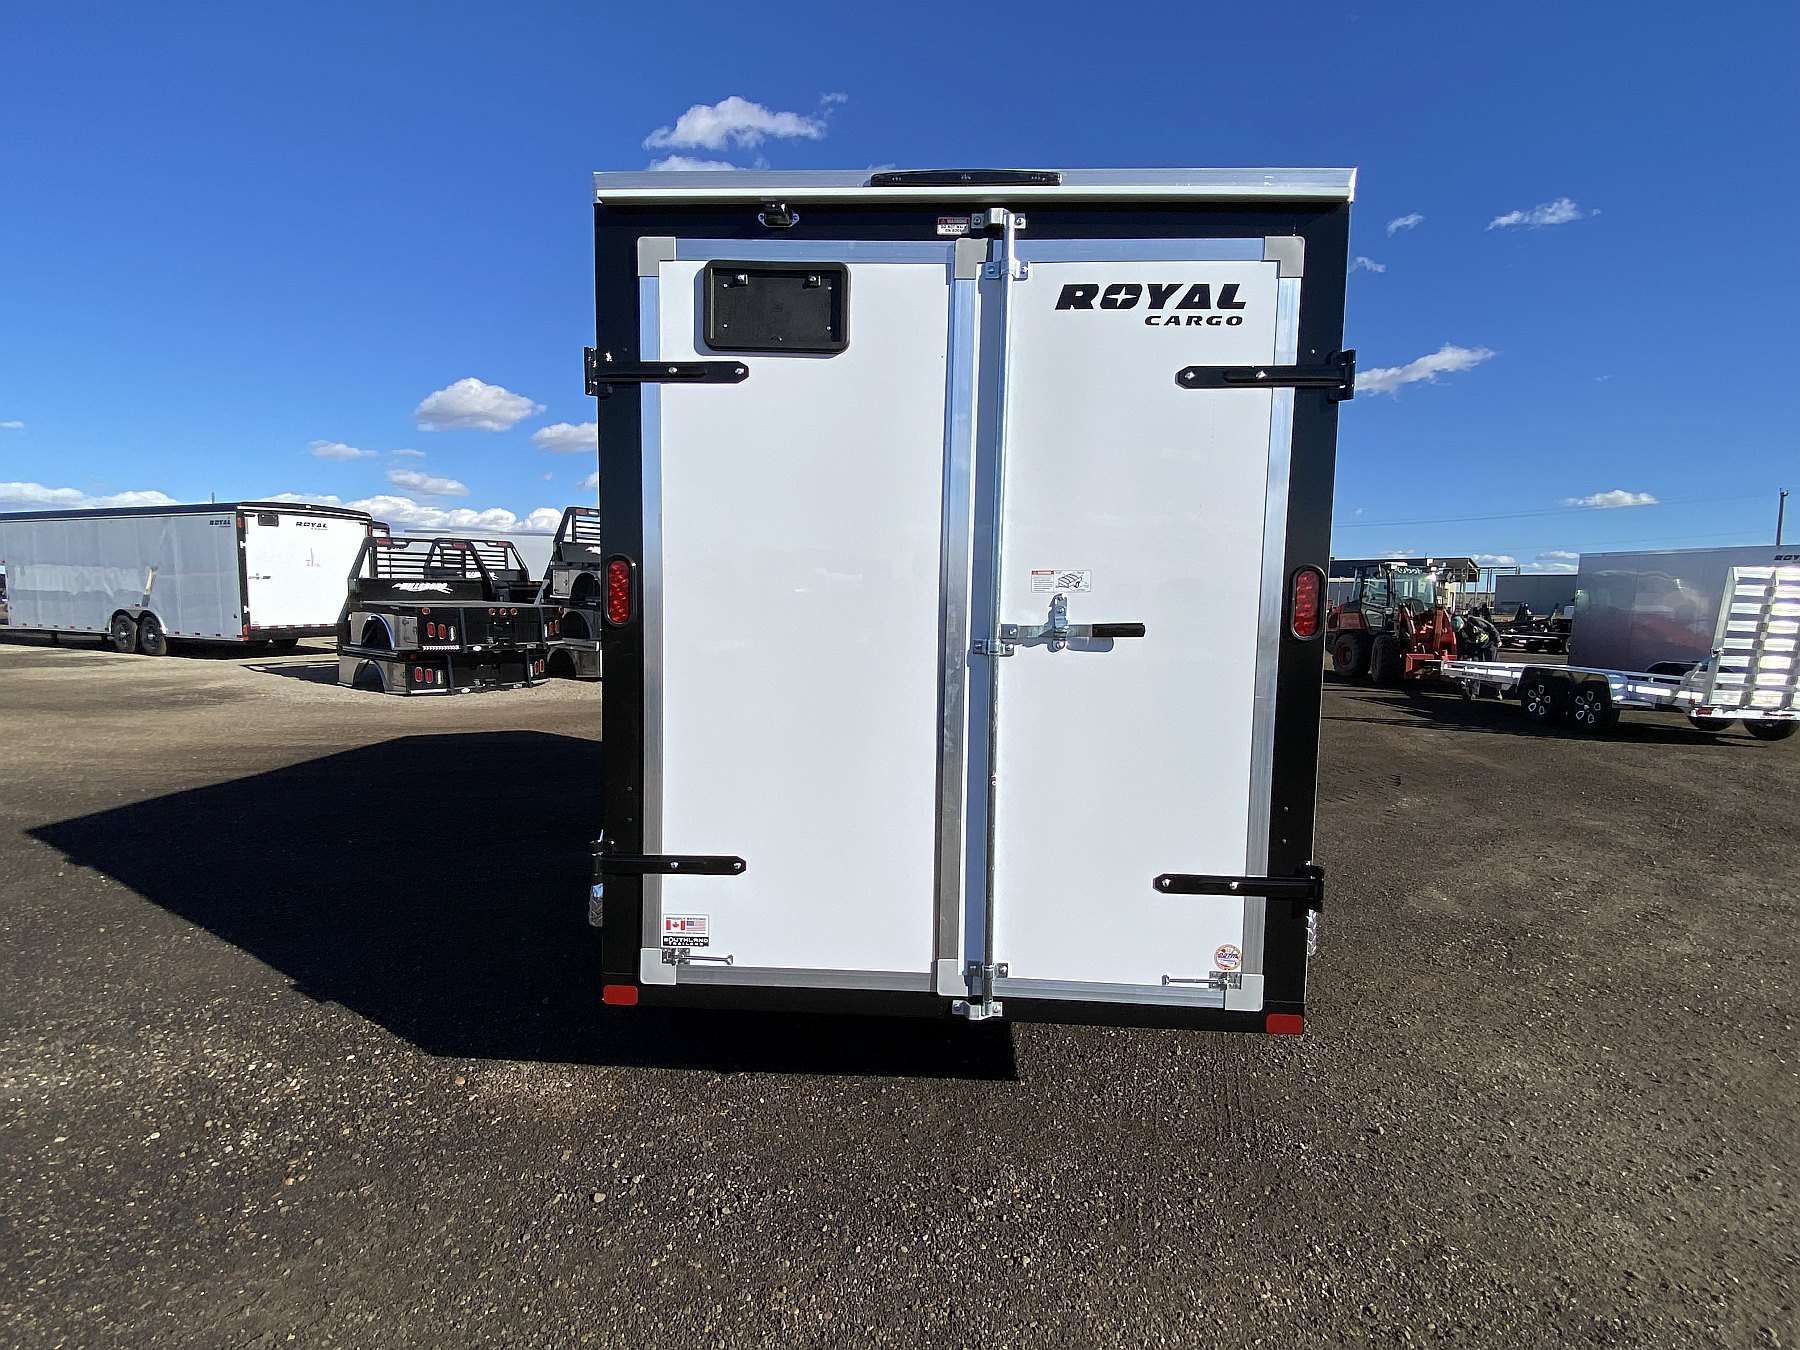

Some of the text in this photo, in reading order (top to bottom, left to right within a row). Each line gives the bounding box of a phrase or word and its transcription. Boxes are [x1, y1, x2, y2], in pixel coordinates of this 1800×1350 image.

[1055, 284, 1246, 310] ROYAL
[1145, 315, 1243, 326] CARGO
[296, 521, 328, 529] ROYAL
